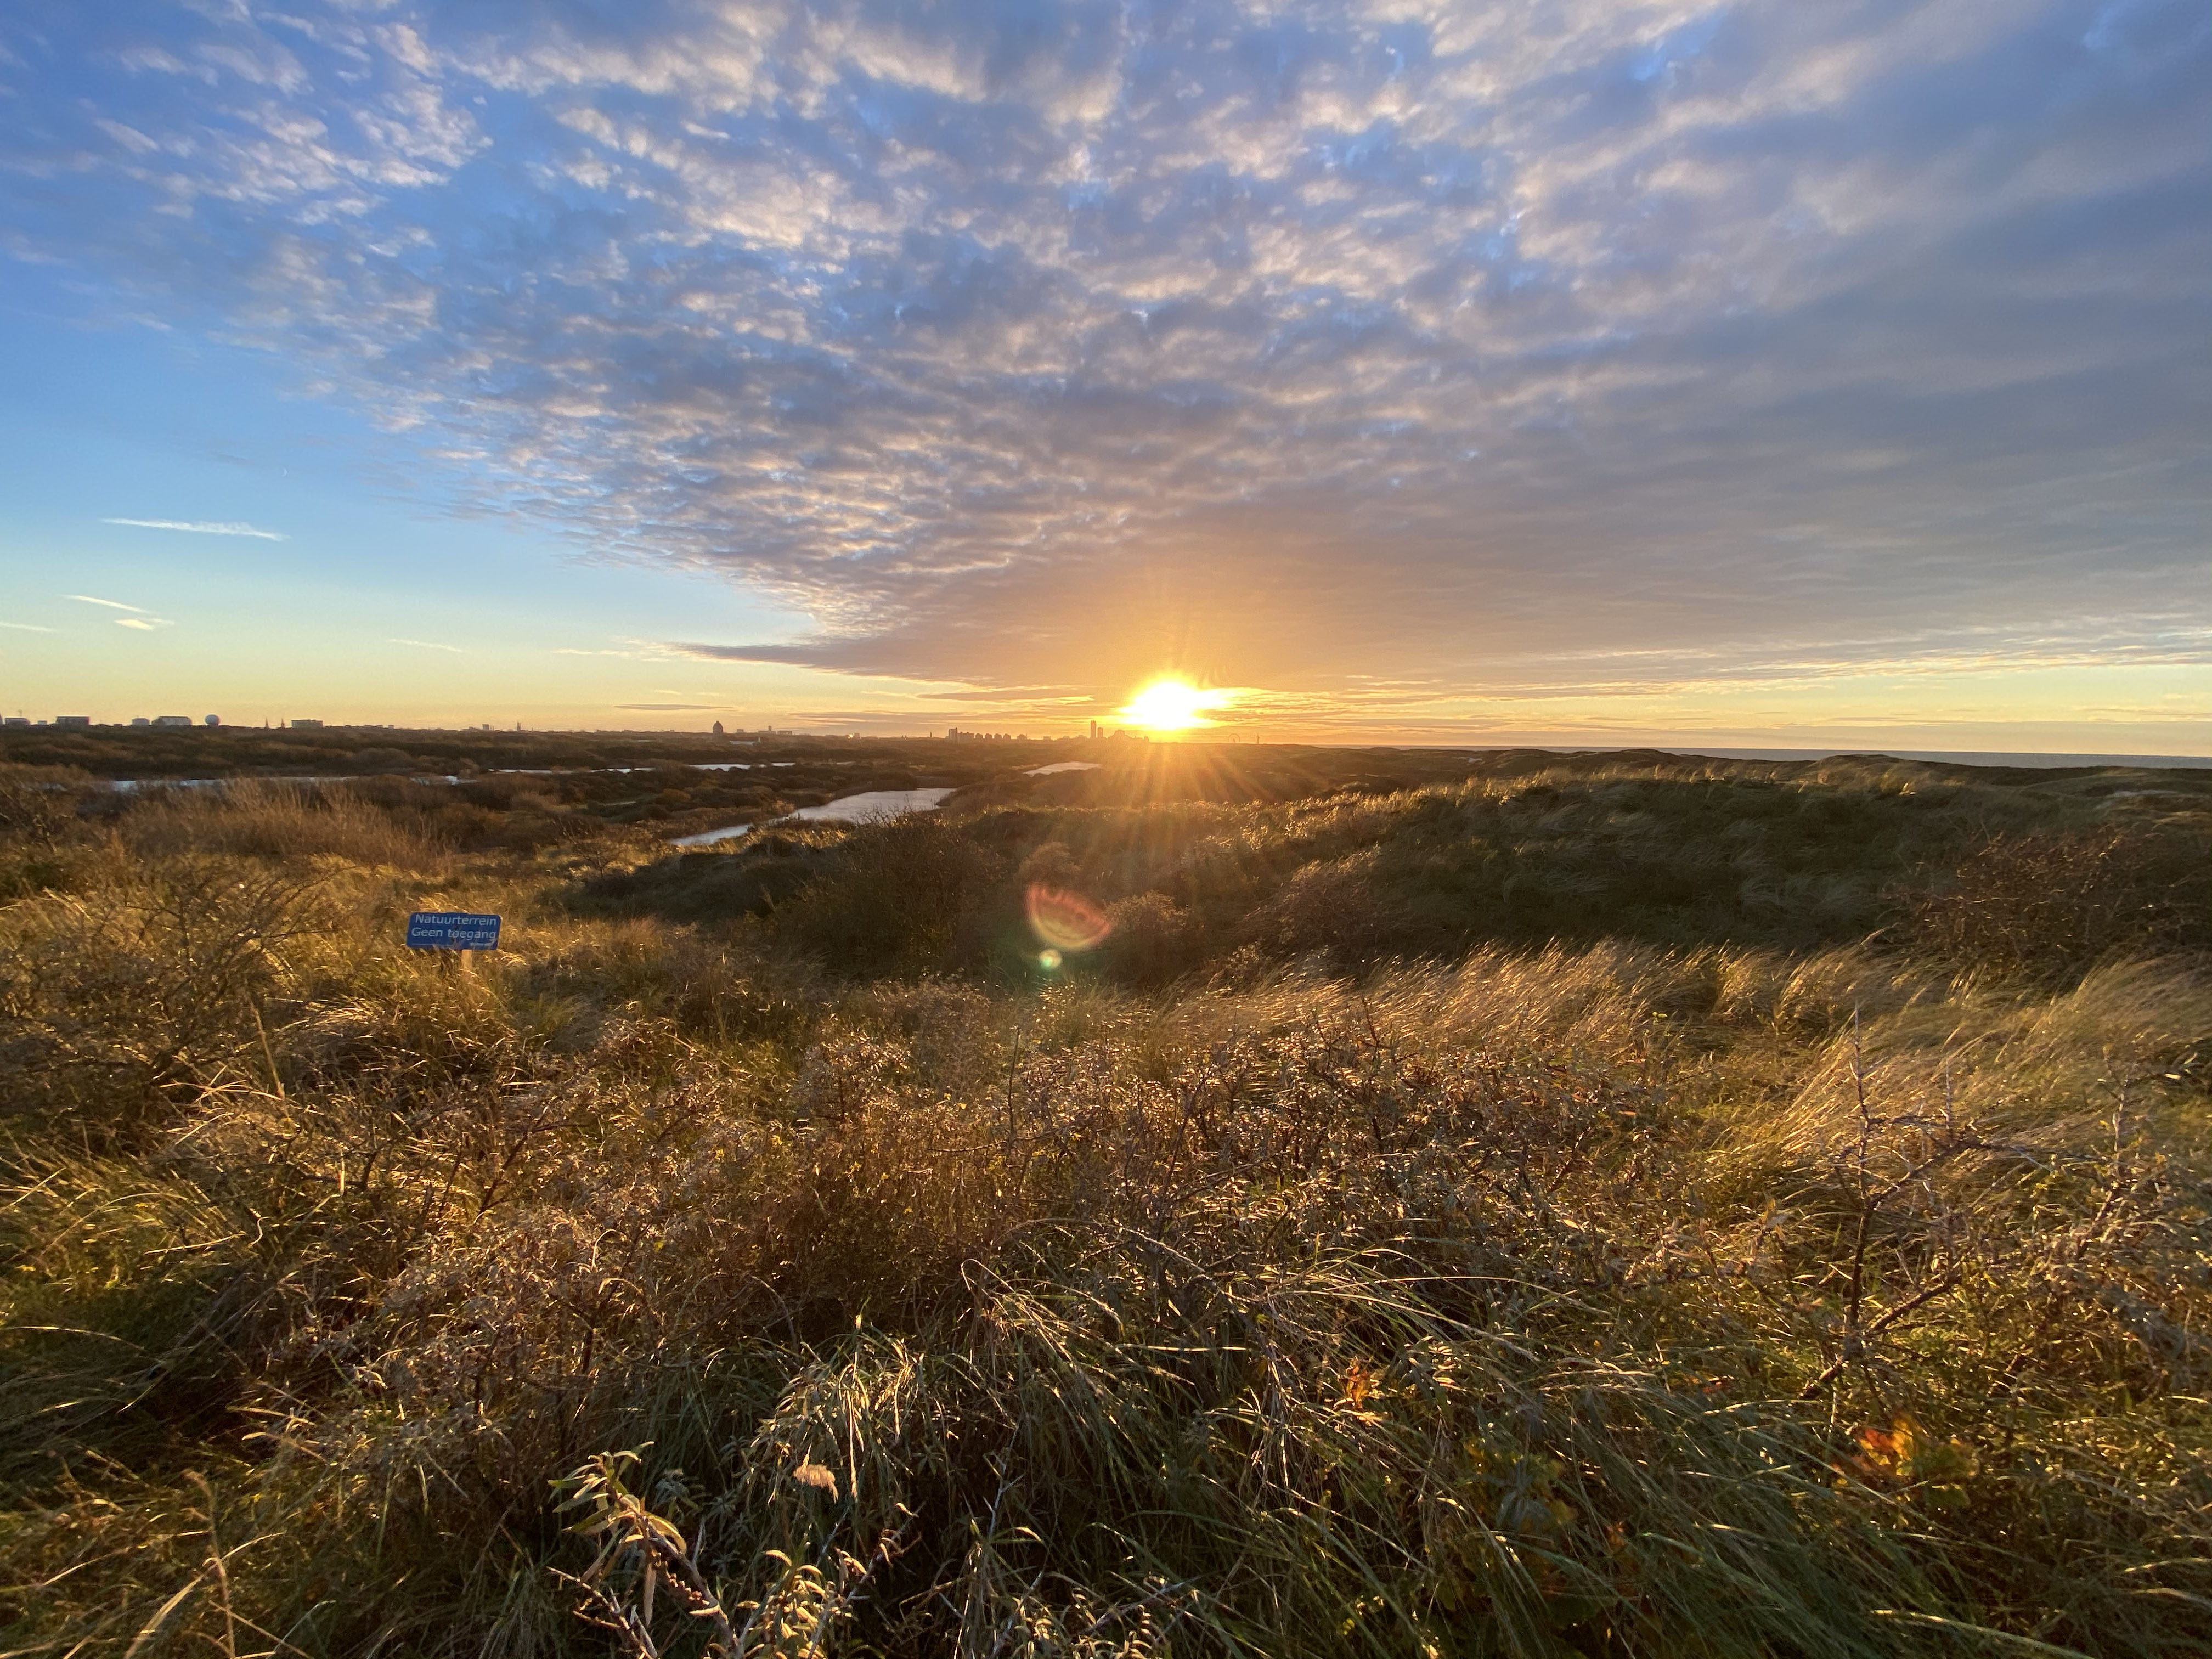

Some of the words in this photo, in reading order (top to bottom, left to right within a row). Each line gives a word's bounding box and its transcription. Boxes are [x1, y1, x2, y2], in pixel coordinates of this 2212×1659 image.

[415, 914, 496, 926] Natuurterrein
[411, 927, 443, 937] Geen
[448, 928, 497, 941] toegang
